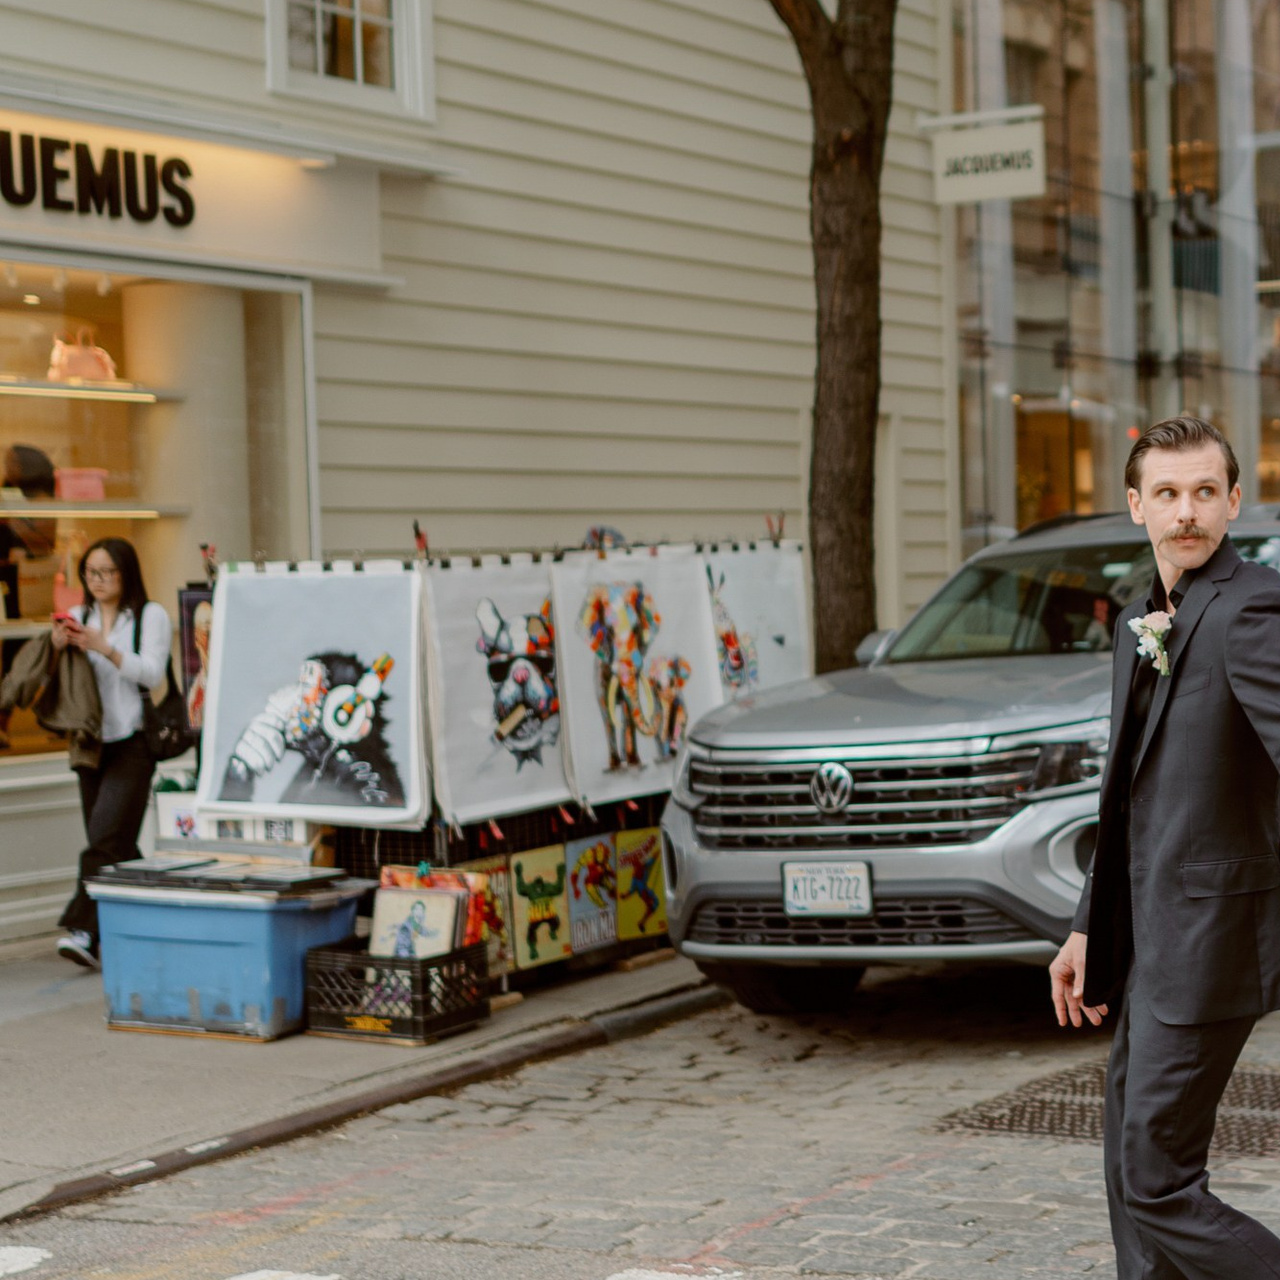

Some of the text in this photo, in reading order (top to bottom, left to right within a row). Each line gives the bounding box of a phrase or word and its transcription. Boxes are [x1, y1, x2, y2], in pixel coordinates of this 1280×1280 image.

[943, 149, 1034, 177] JACQUEMUS
[0, 130, 195, 227] UEMUS
[600, 911, 617, 940] MA
